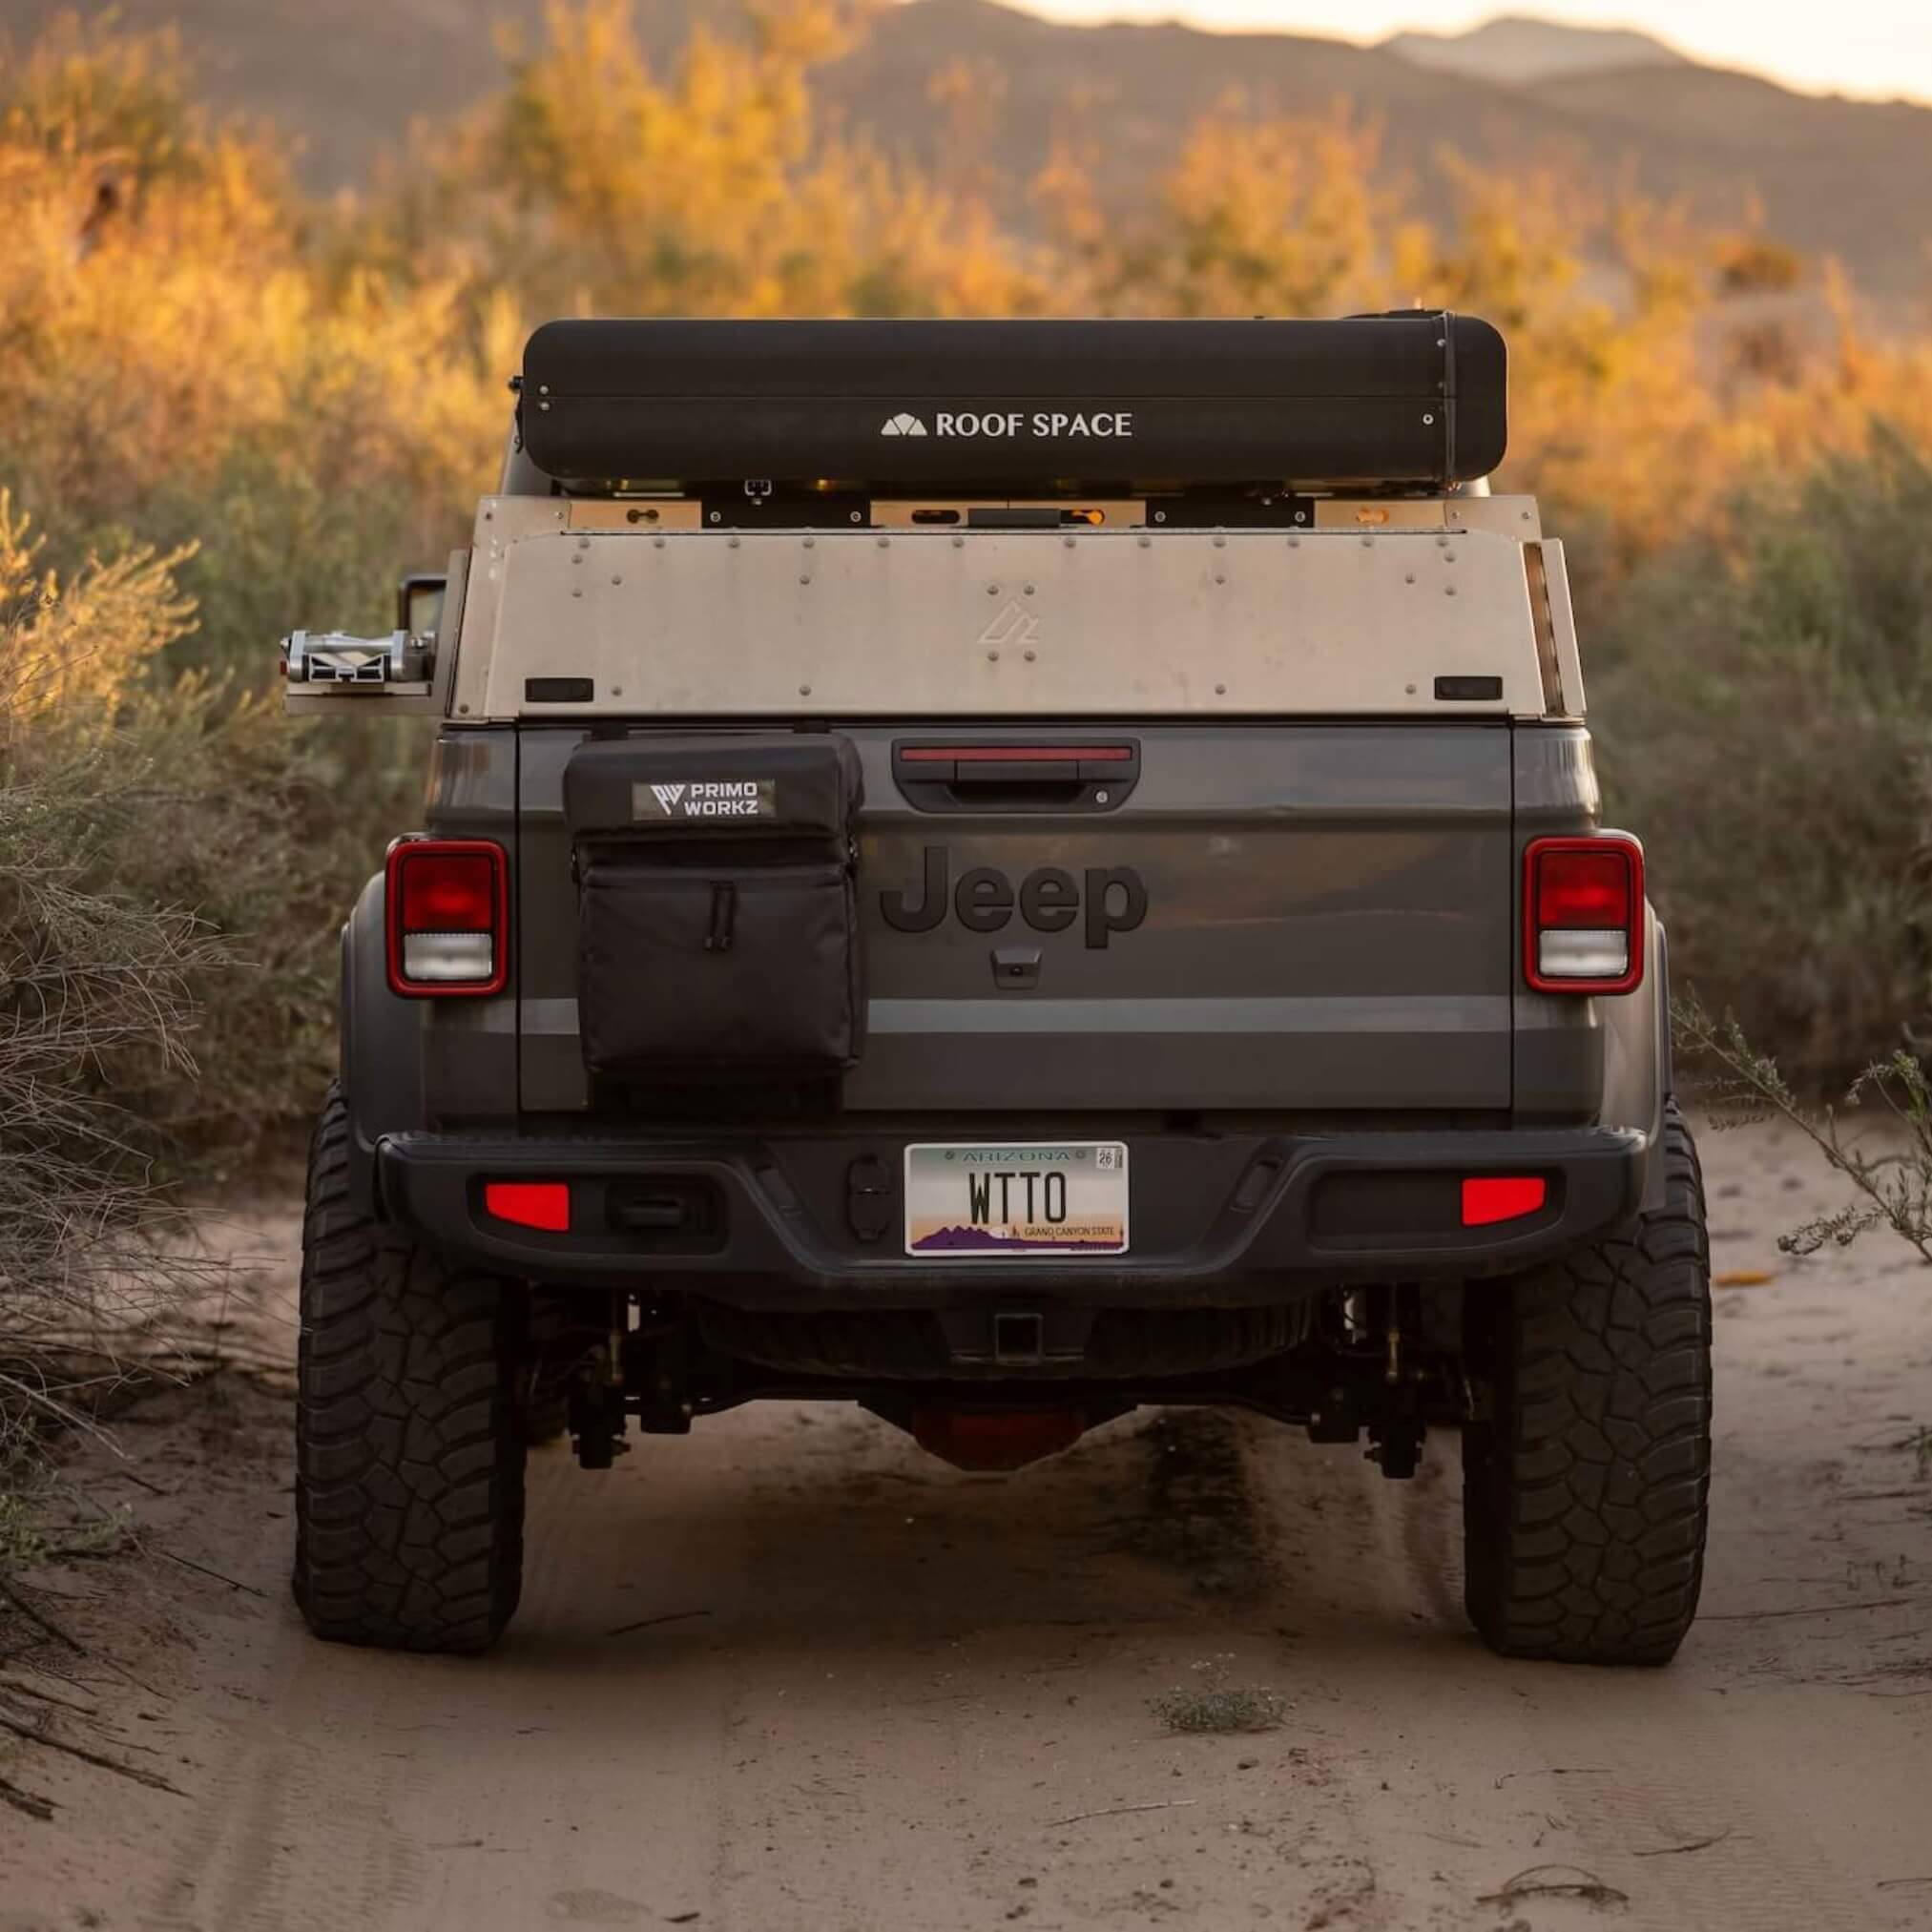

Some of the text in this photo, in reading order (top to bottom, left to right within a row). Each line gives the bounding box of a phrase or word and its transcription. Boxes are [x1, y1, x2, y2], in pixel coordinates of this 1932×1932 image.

[936, 413, 1132, 437] ROOF SPACE
[691, 782, 758, 798] PRIMO
[684, 800, 758, 816] WORKZ
[880, 845, 1148, 949] Jeep
[963, 1151, 1070, 1162] ARIZONA
[969, 1172, 1067, 1224] WTTO
[1025, 1226, 1114, 1237] GRAND CANYON STATE
